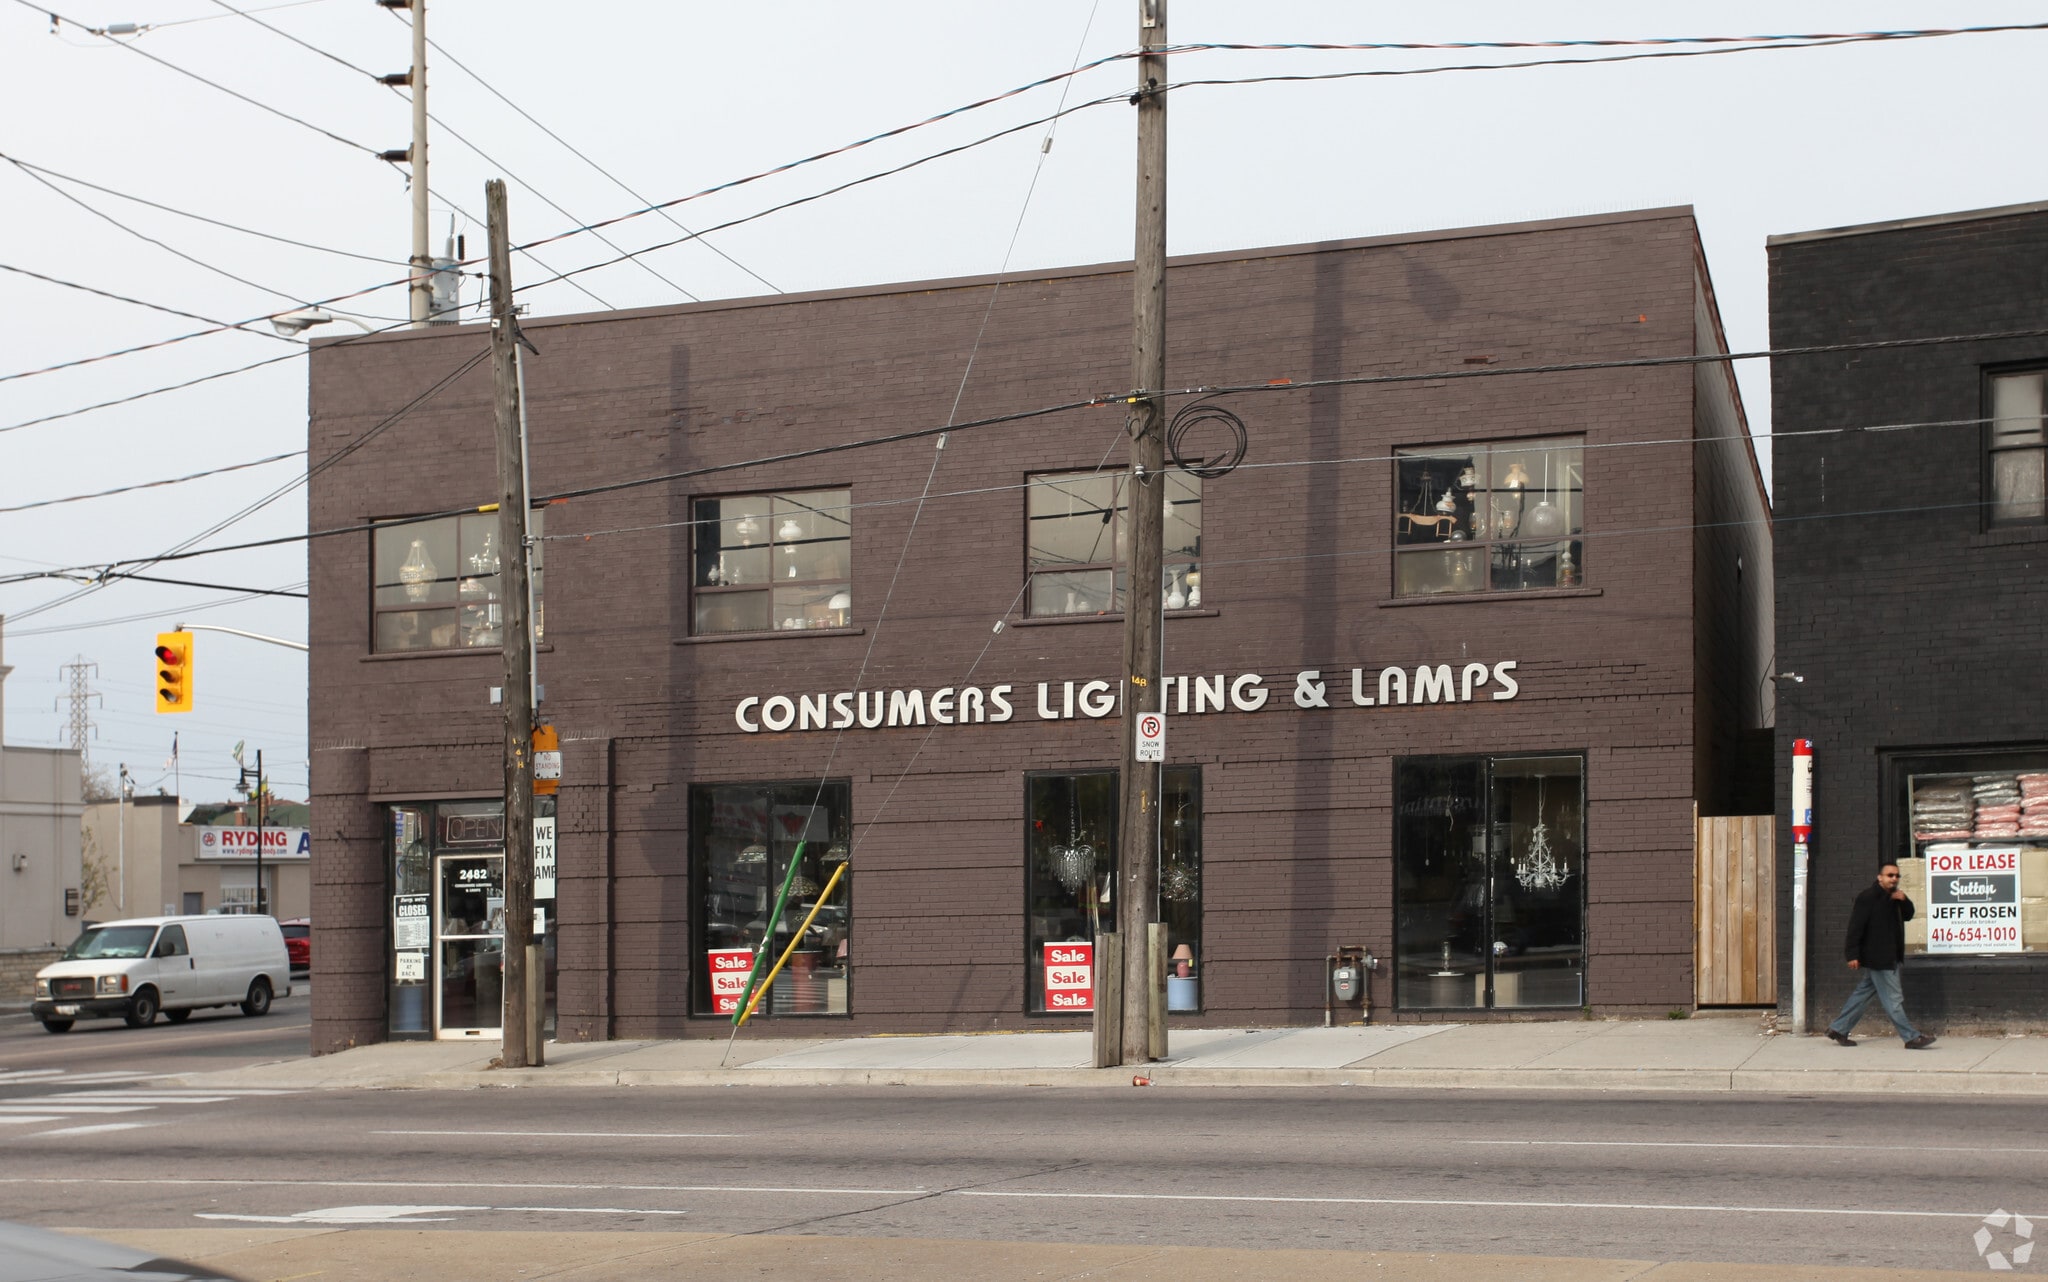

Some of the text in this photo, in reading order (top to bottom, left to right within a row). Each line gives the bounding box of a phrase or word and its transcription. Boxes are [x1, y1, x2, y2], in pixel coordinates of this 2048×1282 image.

[735, 660, 1520, 732] CONSUMERS LIGTING & LAMPS
[1141, 740, 1160, 748] SNOW
[543, 753, 552, 761] NO
[1140, 749, 1161, 757] ROUTE
[535, 761, 560, 771] STANDING
[450, 817, 502, 840] OPEN
[535, 825, 553, 840] WE
[221, 830, 287, 846] RYDNG
[534, 845, 553, 860] FIX
[1930, 853, 2016, 871] FOR LEASE
[459, 868, 488, 880] 2482
[1950, 880, 1997, 896] Sutton
[398, 904, 428, 917] CLOSED
[1932, 905, 2017, 919] JEFF ROSEN
[1931, 926, 2017, 942] 416-654-1010
[715, 955, 747, 969] Sale
[1051, 949, 1086, 963] Sale
[1051, 971, 1086, 984] Sale
[1052, 993, 1088, 1006] Sale
